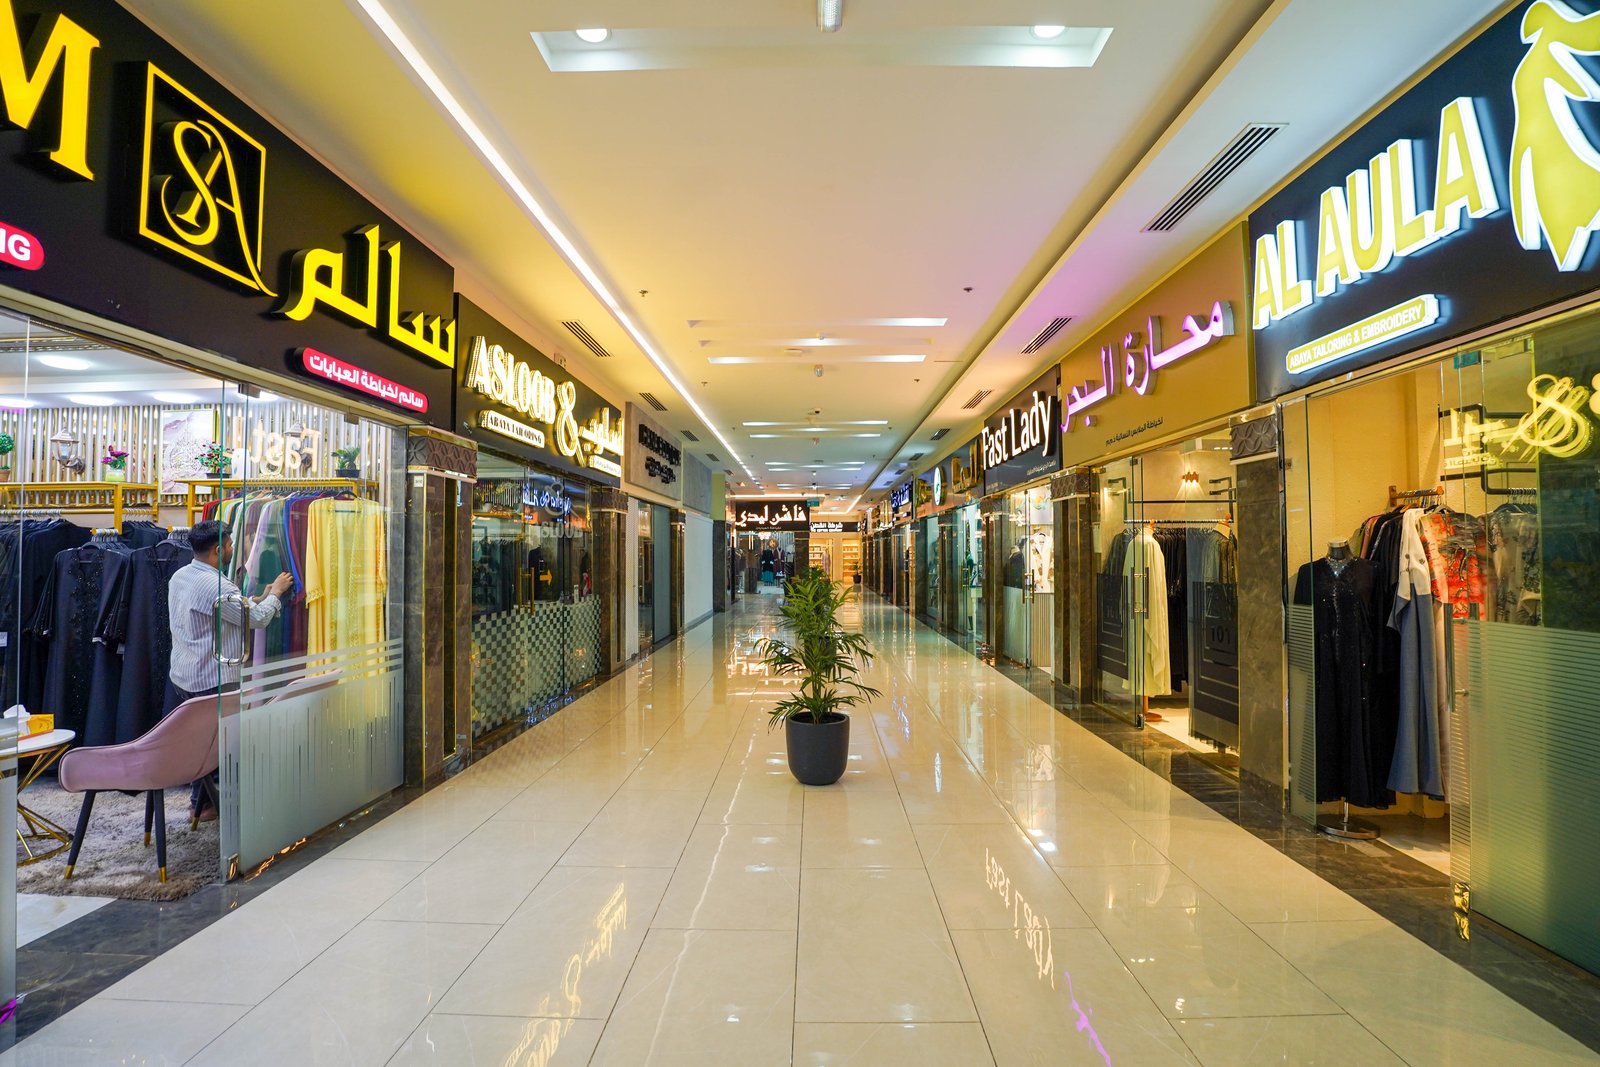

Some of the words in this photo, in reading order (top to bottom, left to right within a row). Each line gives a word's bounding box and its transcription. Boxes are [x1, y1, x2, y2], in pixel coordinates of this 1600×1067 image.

[1252, 220, 1314, 330] AL
[1316, 96, 1501, 298] AULA
[285, 223, 456, 370] سالم
[1290, 349, 1313, 368] ABAYA
[1312, 331, 1353, 359] TAILORING
[1353, 331, 1361, 343] &
[1361, 303, 1423, 341] EMBROIDERY
[309, 355, 359, 385] العبايات
[360, 369, 399, 399] لخياطة
[466, 335, 556, 425] ASLOOB
[1123, 299, 1225, 396] محارة
[398, 390, 424, 408] سالم
[1060, 341, 1115, 434] البحر
[981, 416, 1008, 470] Fast
[1009, 391, 1052, 458] Lady
[735, 504, 769, 527] ليدي
